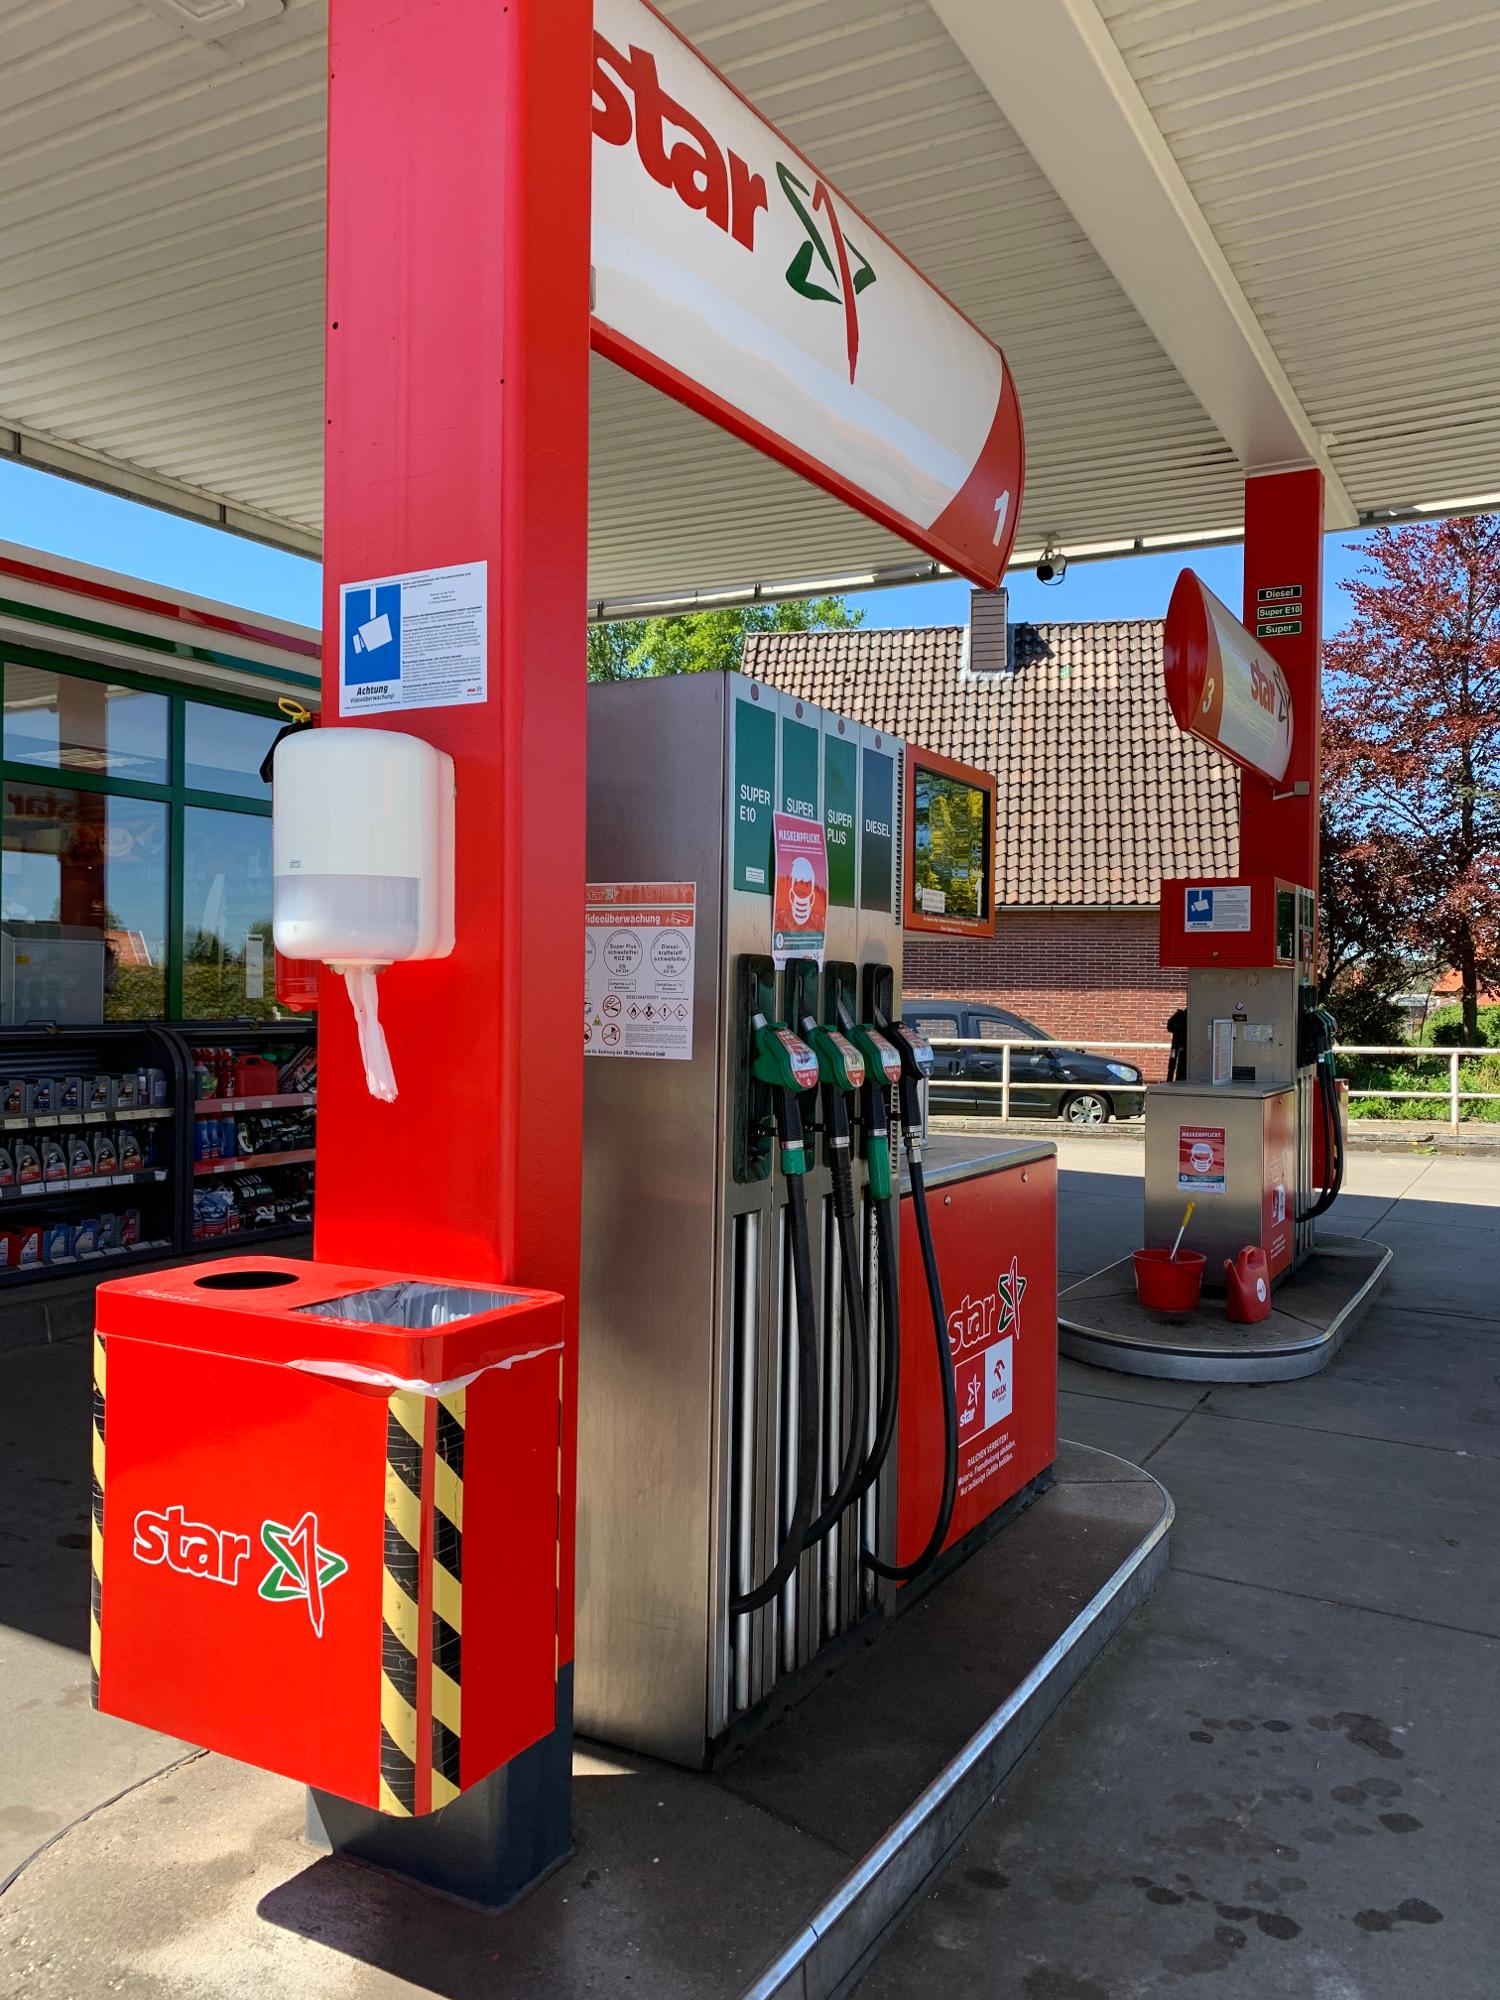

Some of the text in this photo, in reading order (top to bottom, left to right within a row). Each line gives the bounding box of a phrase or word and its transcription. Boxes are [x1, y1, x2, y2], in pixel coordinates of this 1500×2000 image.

[591, 29, 768, 253] star
[992, 490, 1009, 547] 1
[1265, 588, 1294, 598] Diesel
[1259, 605, 1300, 617] Super E10
[1265, 624, 1292, 634] Super
[356, 683, 389, 696] Achtung
[1202, 678, 1214, 713] 3
[1250, 658, 1276, 715] star
[740, 784, 771, 807] SUPER
[740, 806, 756, 823] E10
[786, 797, 814, 818] SUPER
[827, 808, 852, 828] SUPER
[827, 827, 847, 845] PLUS
[865, 819, 891, 838] DIESEL
[947, 1293, 996, 1356] star
[991, 1384, 1007, 1400] ORLEN
[959, 1406, 976, 1428] star
[967, 1447, 987, 1467] RAUCHEN
[133, 1505, 250, 1586] star
